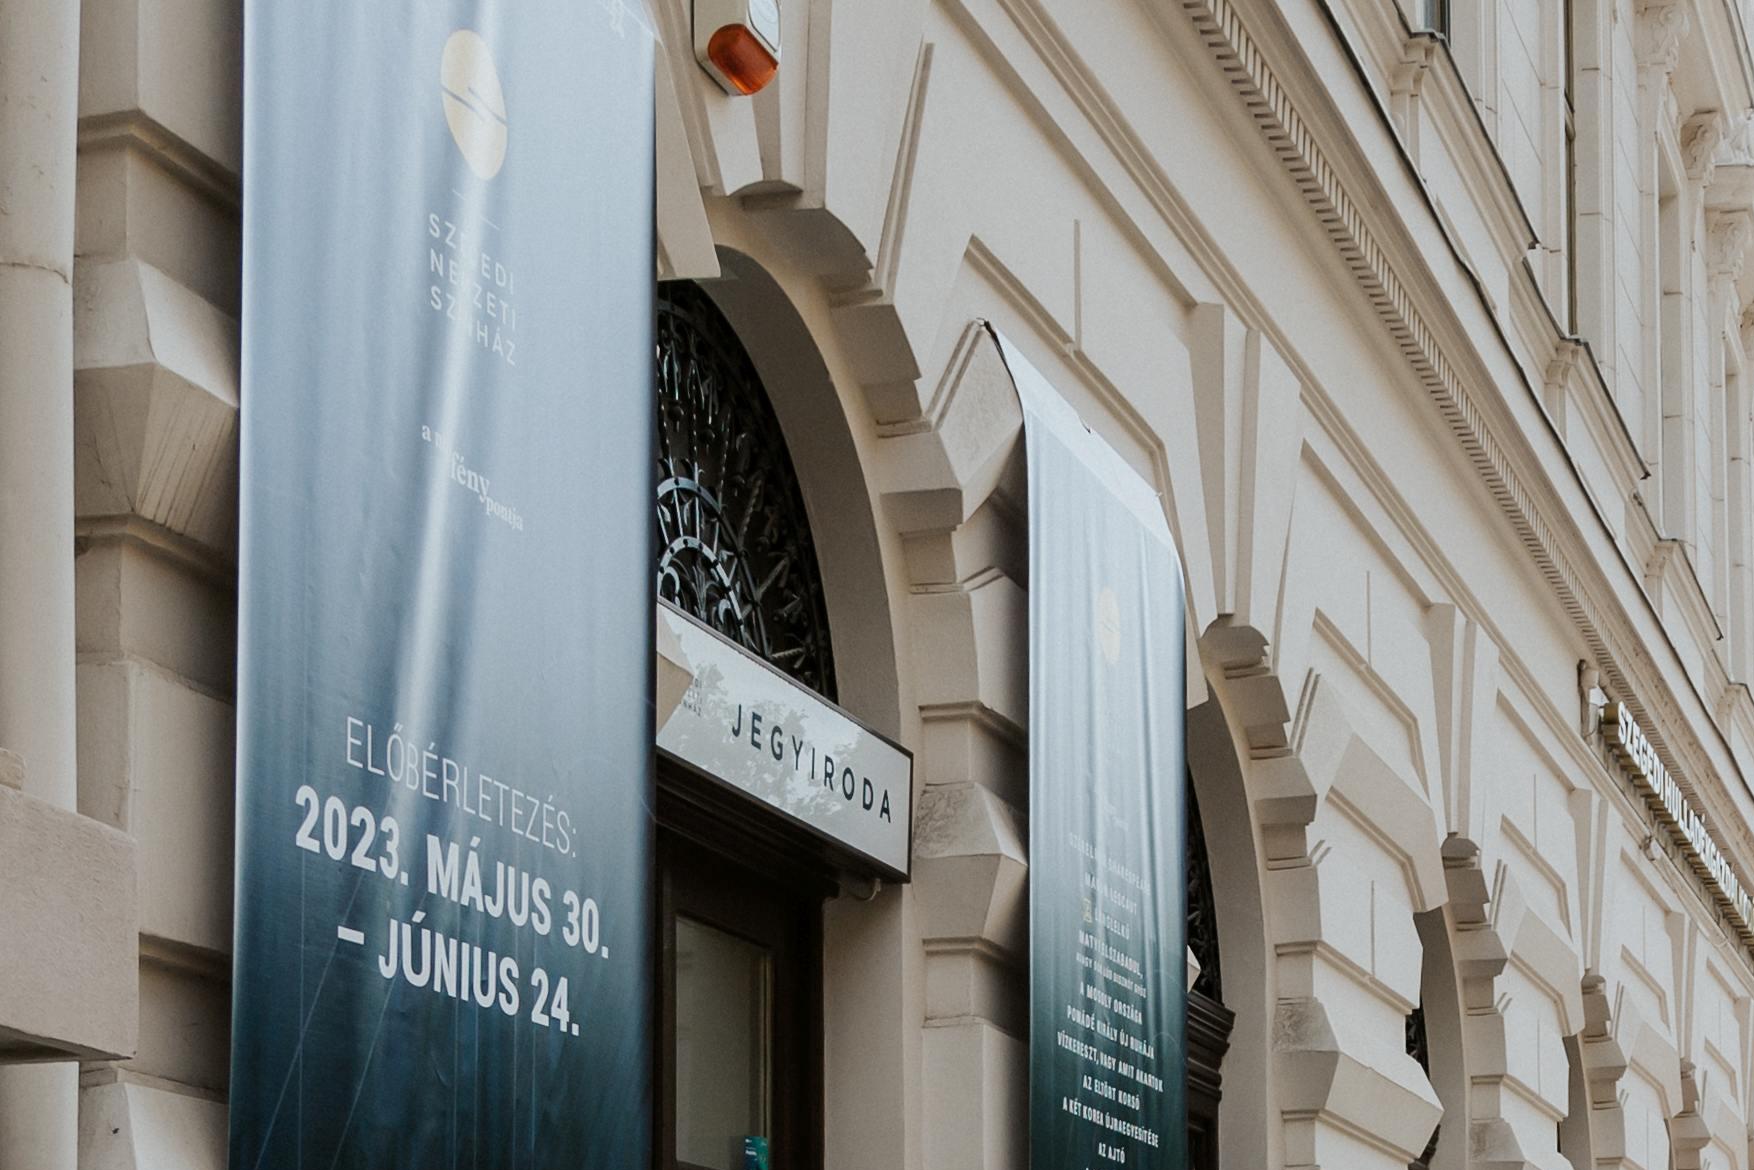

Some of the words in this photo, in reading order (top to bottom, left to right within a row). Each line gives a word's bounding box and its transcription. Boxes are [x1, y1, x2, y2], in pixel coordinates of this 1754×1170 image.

[429, 213, 514, 296] SZEDI
[430, 285, 516, 367] SZHÁZ
[422, 425, 431, 442] a
[347, 716, 576, 858] ELŐBÉRLETEZÉS:
[732, 704, 891, 823] JEGYIRODA
[1618, 701, 1664, 801] SZEGEDI
[295, 785, 408, 886] 2023.
[427, 836, 551, 936] MÁJUS
[562, 890, 609, 959] 30.
[1085, 871, 1110, 898] MAN
[378, 911, 520, 1016] JÚNIUS
[531, 967, 580, 1036] 24.
[1113, 999, 1142, 1025] ORSZÁGA
[1069, 1098, 1082, 1117] KÉT
[1082, 1074, 1092, 1090] AZ
[1098, 1142, 1106, 1157] AZ
[1108, 1146, 1125, 1164] AJTÓ
